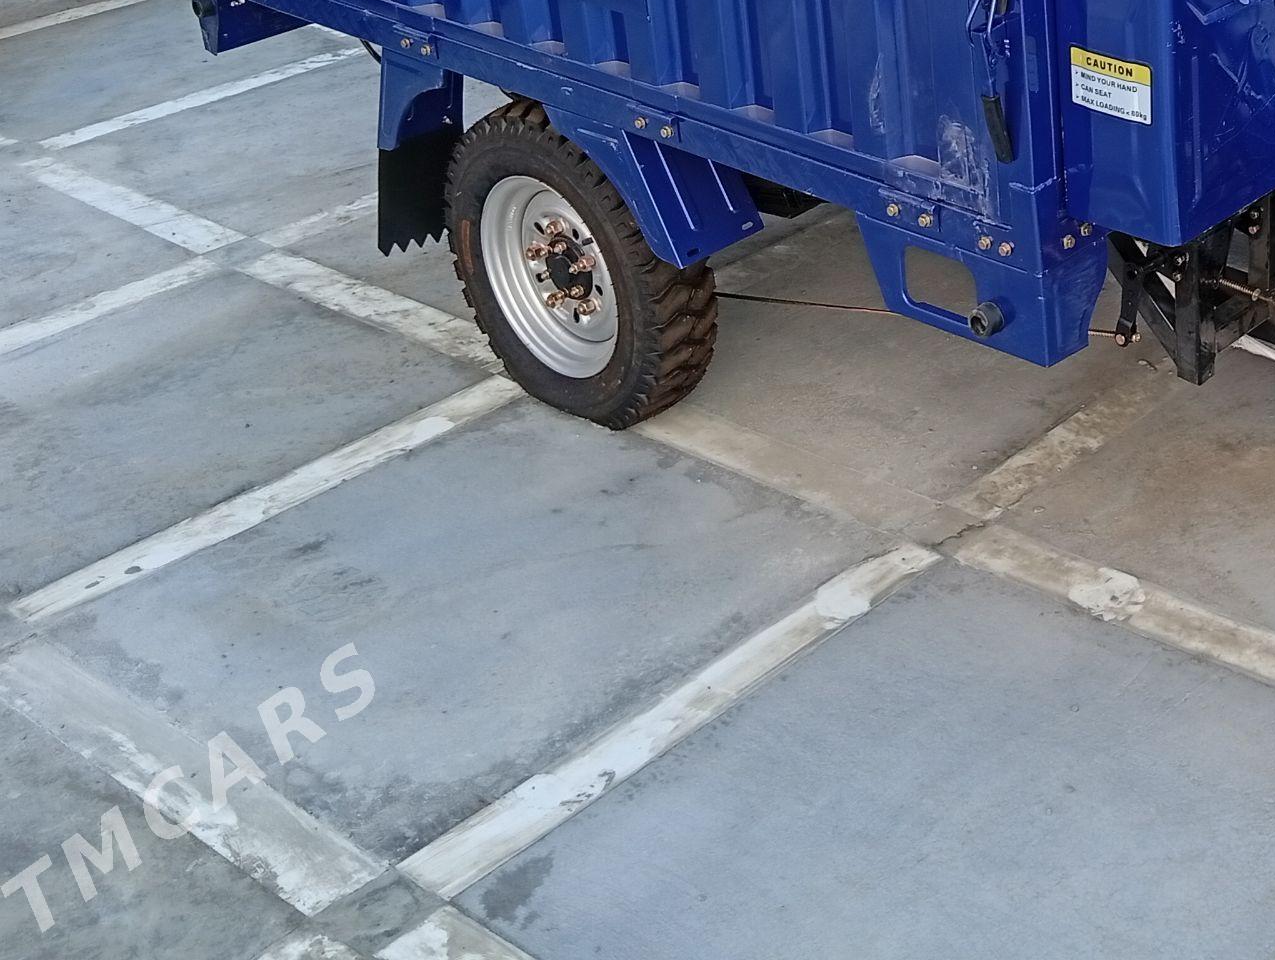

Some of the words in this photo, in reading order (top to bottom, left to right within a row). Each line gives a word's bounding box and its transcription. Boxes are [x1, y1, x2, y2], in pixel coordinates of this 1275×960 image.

[1086, 56, 1133, 77] CAUTION
[1080, 71, 1096, 82] MIND
[1097, 76, 1116, 88] YOUR
[1116, 83, 1138, 93] HAND
[1080, 83, 1094, 93] CAN
[1094, 88, 1112, 99] SEAT
[1081, 95, 1095, 105] MAX
[1096, 100, 1125, 115] LOADING
